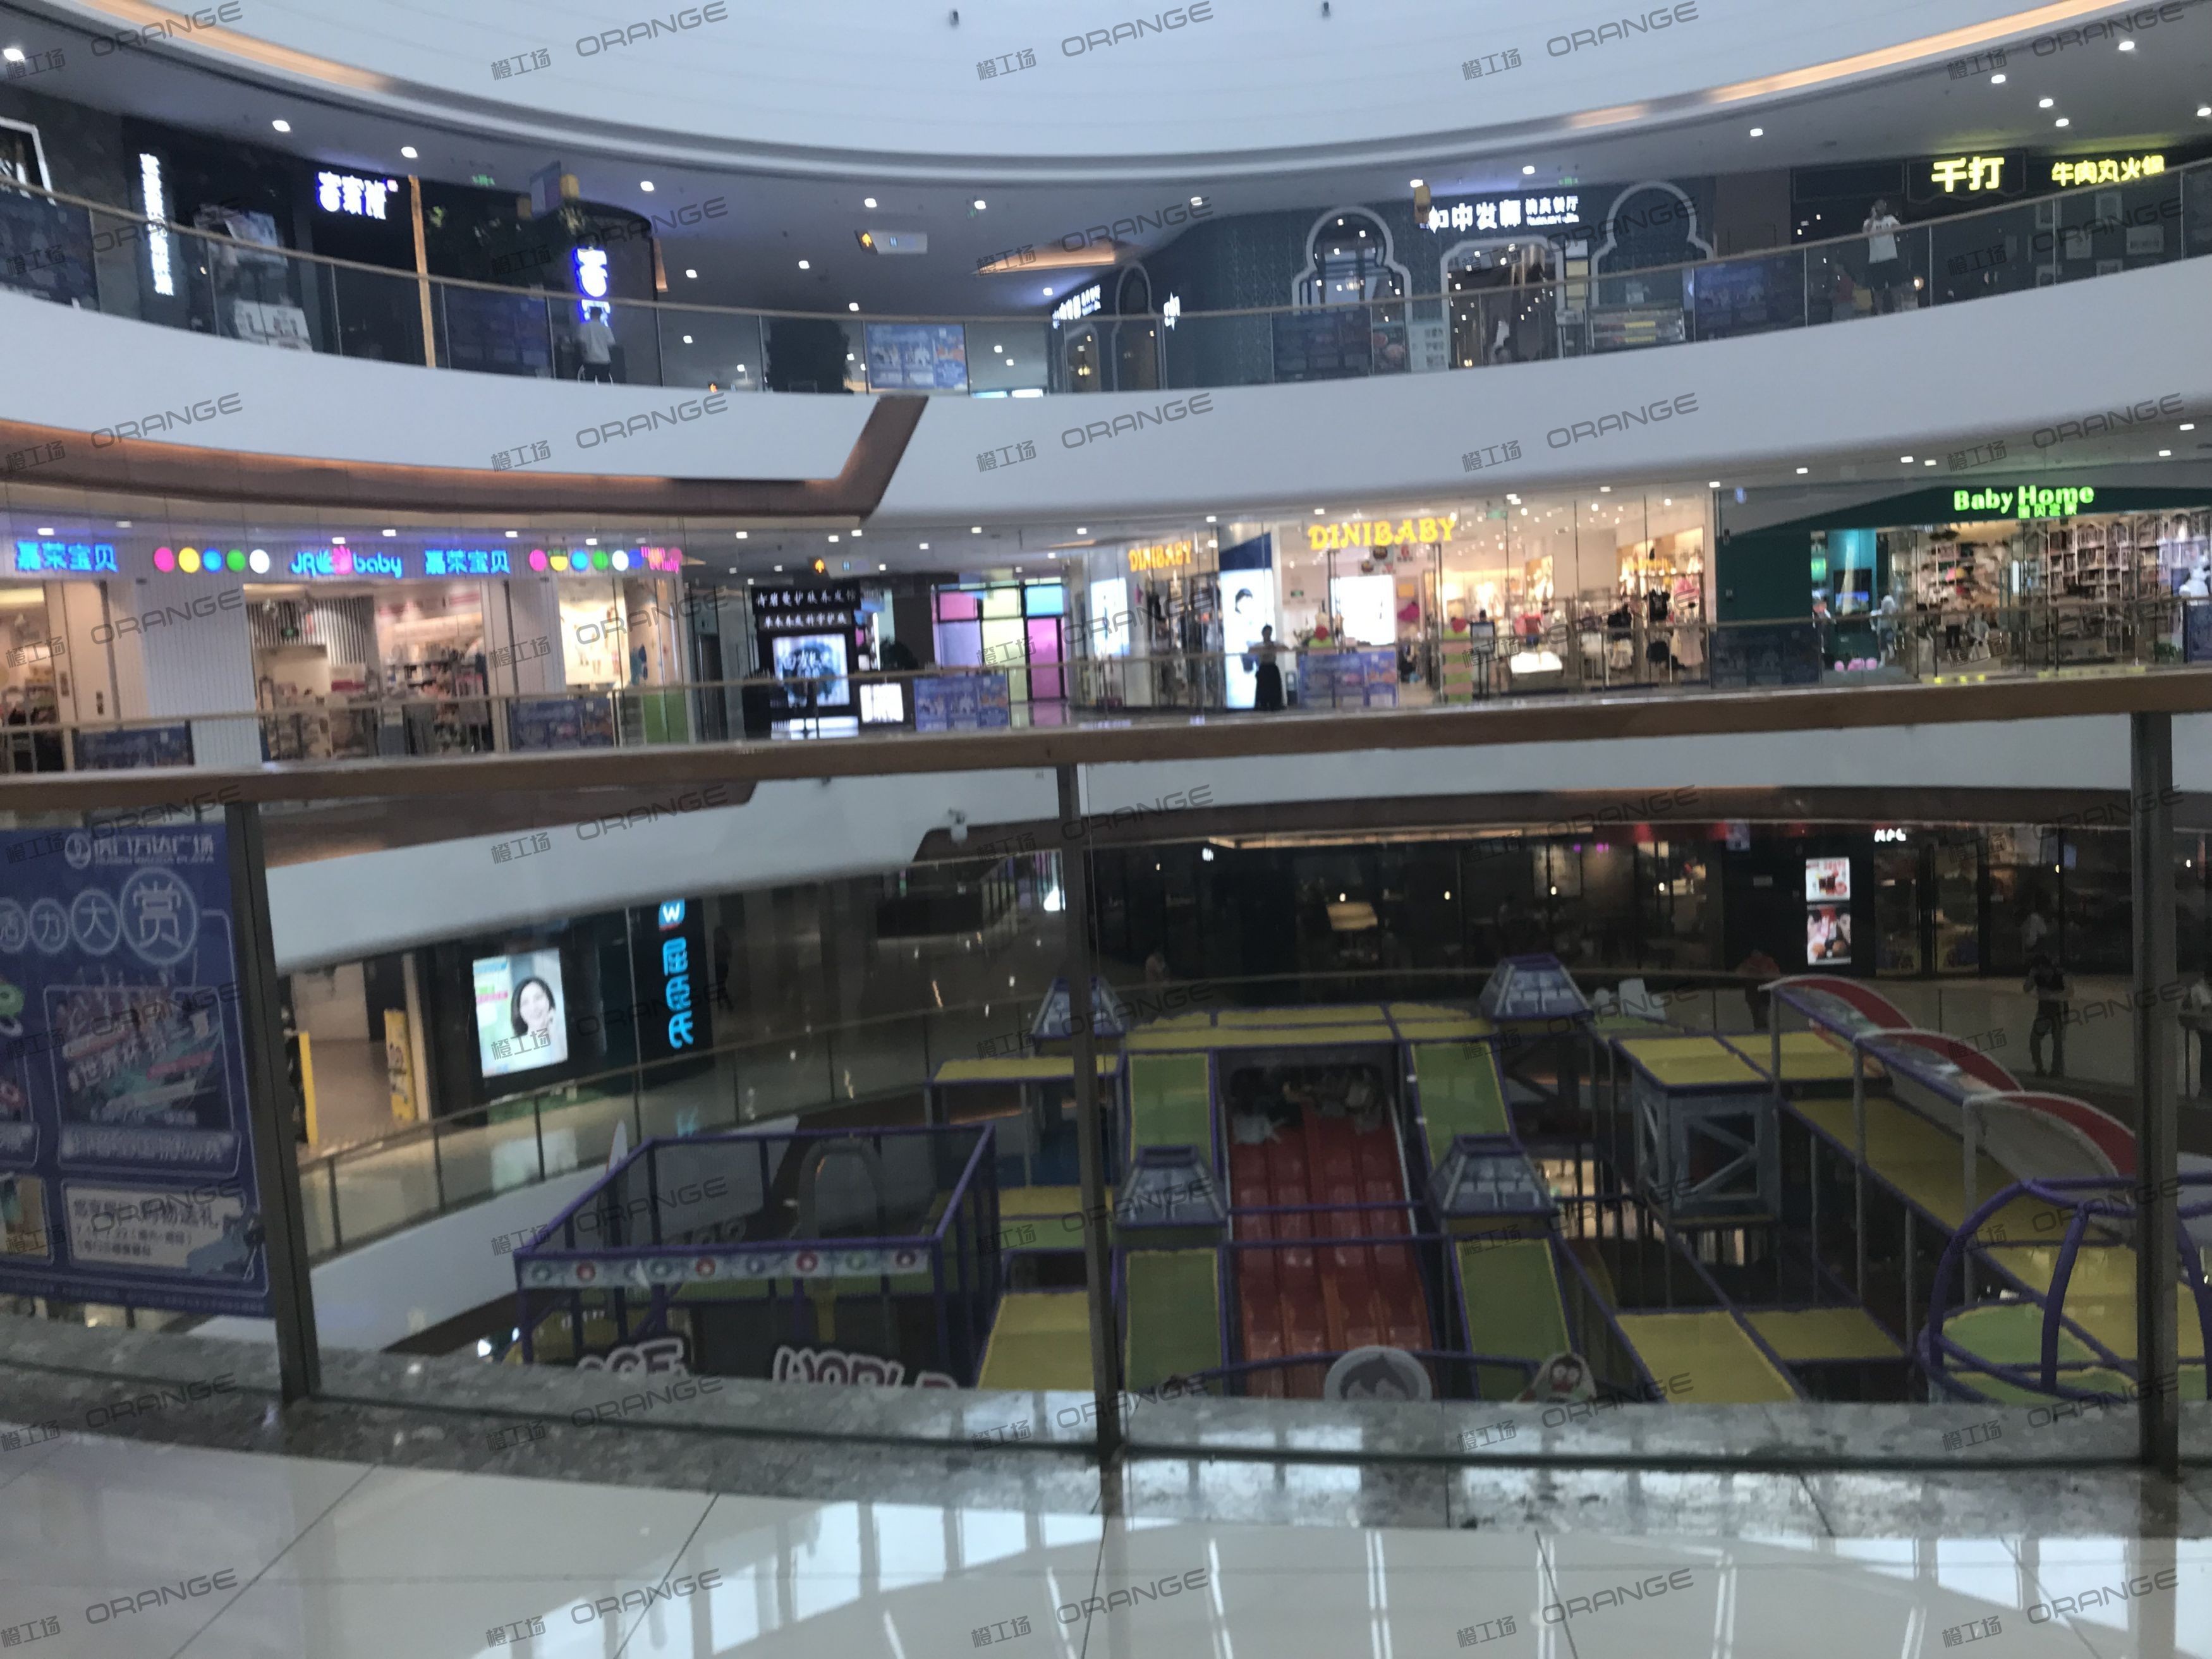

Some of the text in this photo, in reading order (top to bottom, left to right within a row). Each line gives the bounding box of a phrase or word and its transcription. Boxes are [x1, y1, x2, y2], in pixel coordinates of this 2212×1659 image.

[1954, 487, 2014, 514] Baby
[2017, 485, 2094, 506] Home
[1308, 516, 1456, 550] DINIBABY
[1129, 540, 1192, 571] DINIBABY
